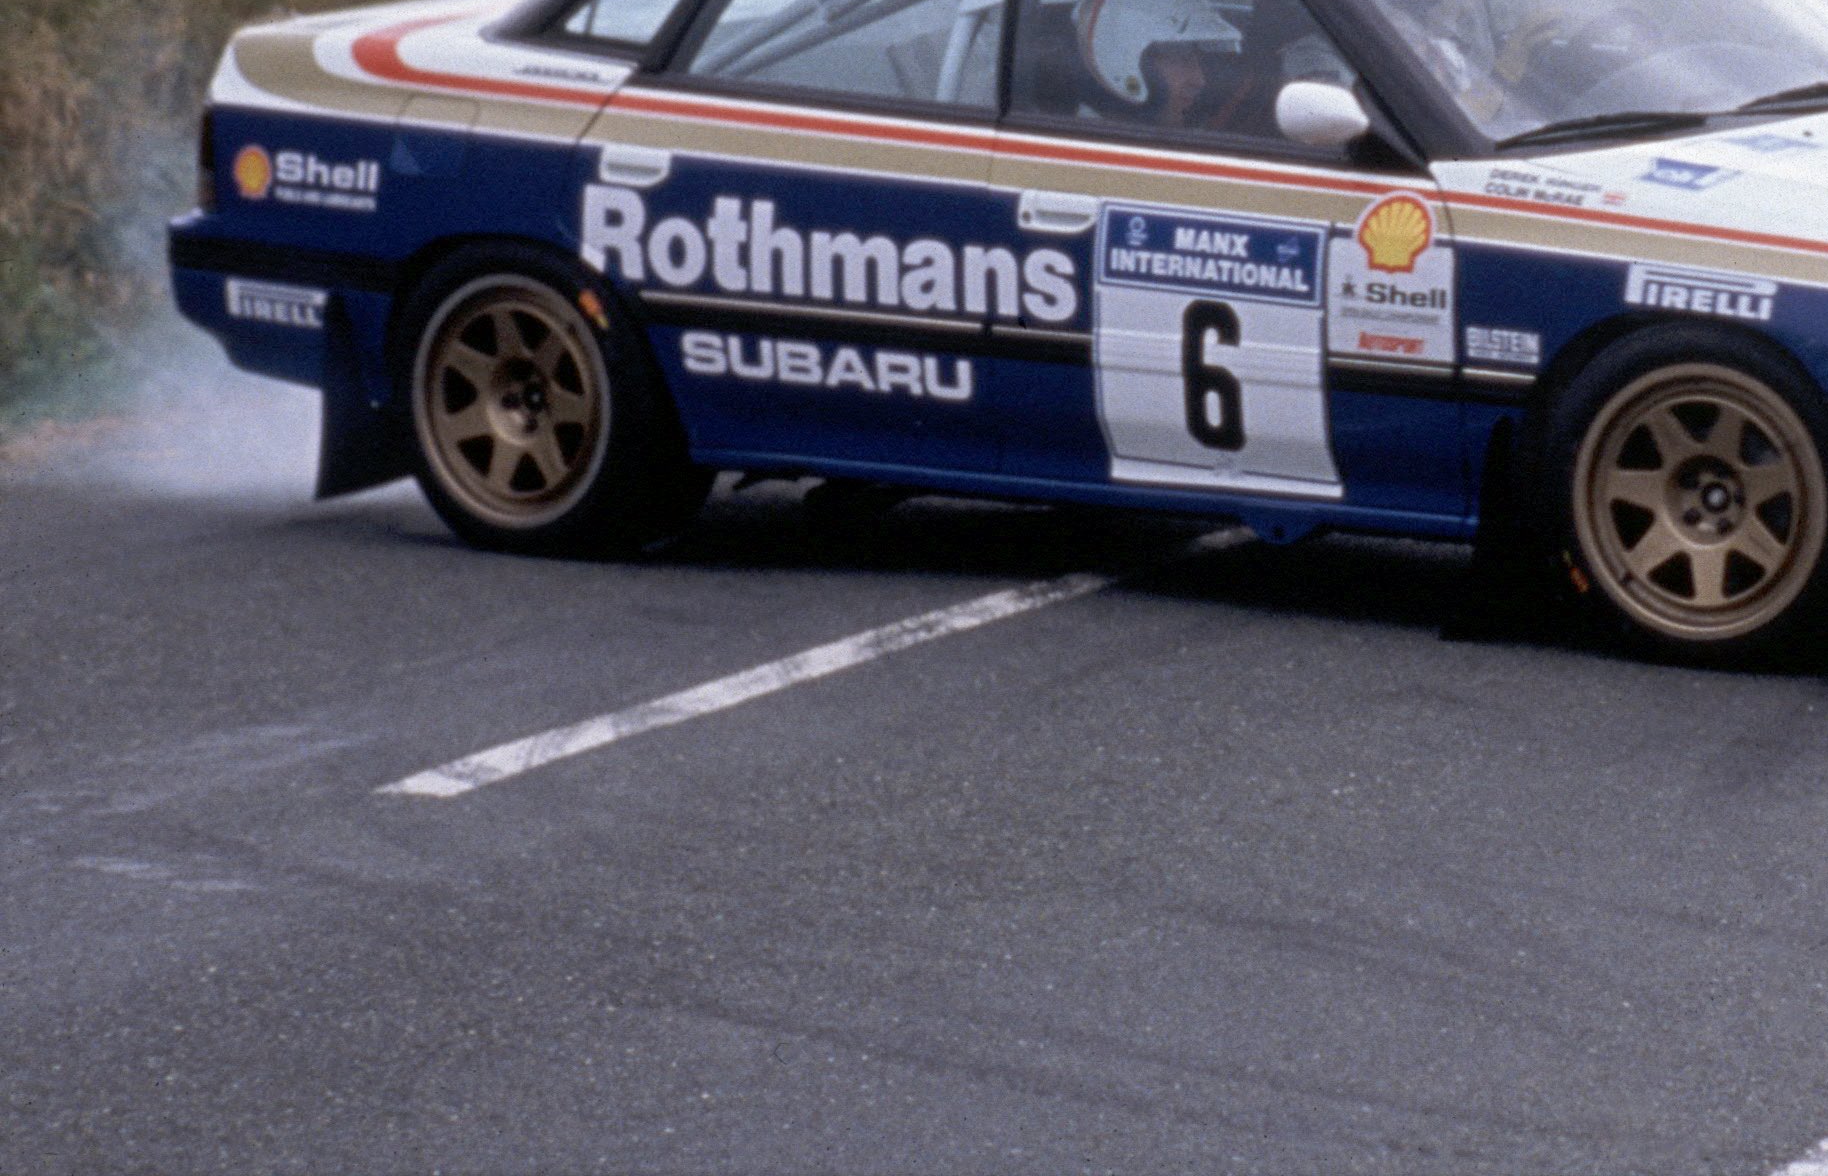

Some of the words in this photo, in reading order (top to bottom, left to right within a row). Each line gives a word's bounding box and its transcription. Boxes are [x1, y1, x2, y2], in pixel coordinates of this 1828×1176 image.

[275, 150, 379, 192] Shell
[580, 183, 1078, 322] Rothmans
[1174, 227, 1249, 257] MANX
[1110, 248, 1310, 293] INTERNATIONAL
[1366, 282, 1447, 310] Shell
[1625, 263, 1777, 321] PIRELLI
[682, 332, 973, 401] SUBARU
[1181, 299, 1246, 452] 6
